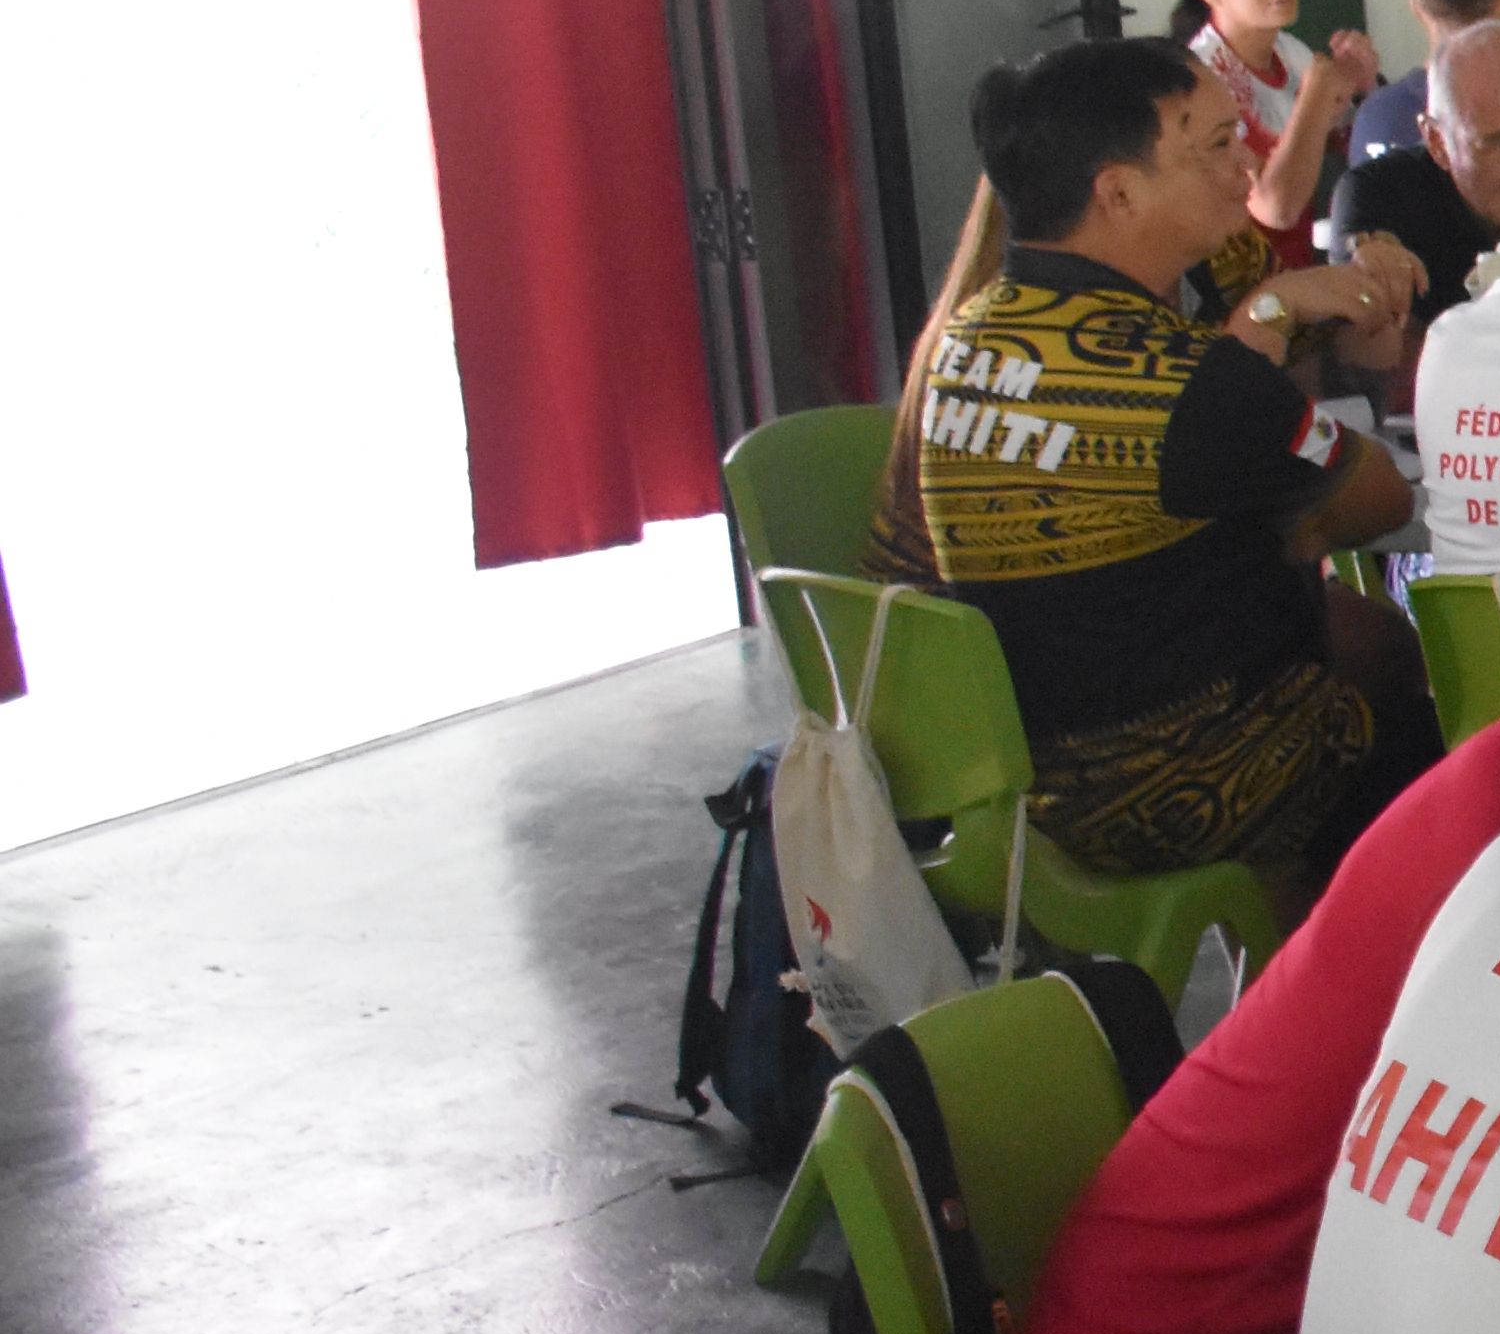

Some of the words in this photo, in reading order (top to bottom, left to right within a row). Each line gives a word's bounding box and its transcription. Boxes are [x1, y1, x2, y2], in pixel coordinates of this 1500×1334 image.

[930, 336, 1045, 401] TEAM
[922, 385, 1076, 473] HITI
[1466, 498, 1499, 527] DE
